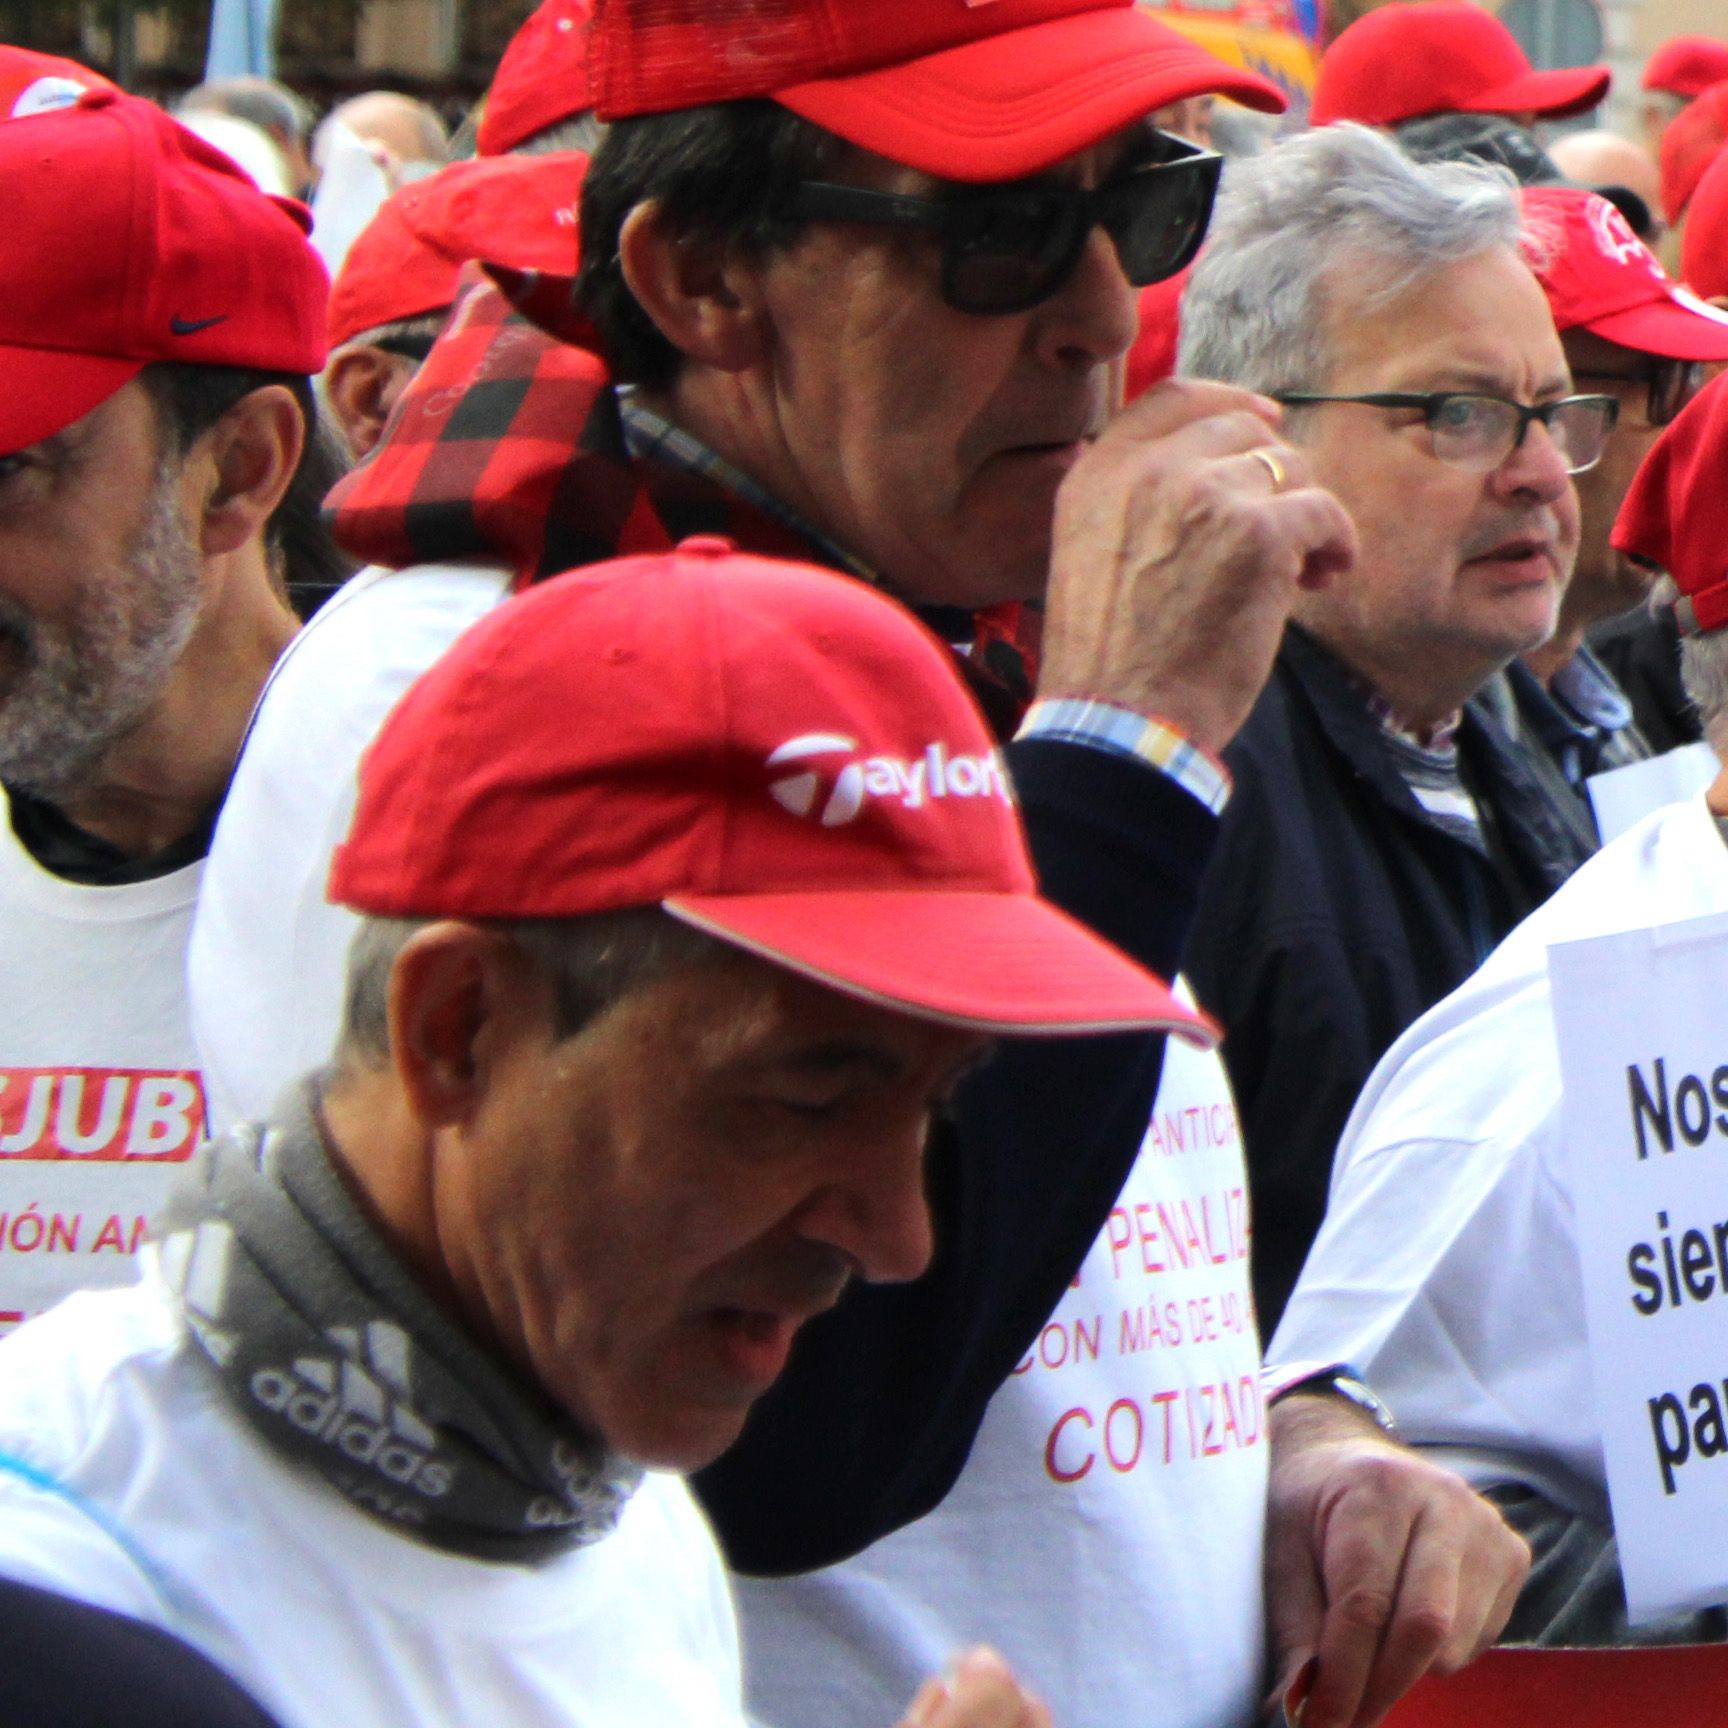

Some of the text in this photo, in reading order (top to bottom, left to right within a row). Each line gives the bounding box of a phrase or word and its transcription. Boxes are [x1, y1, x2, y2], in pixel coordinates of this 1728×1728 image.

[0, 1074, 197, 1155] JUB
[1106, 1187, 1251, 1280] PENALIZ
[1118, 1292, 1182, 1357] MÁS
[1187, 1296, 1219, 1345] DE
[1221, 1291, 1243, 1337] 40
[250, 1367, 454, 1497] adidas
[1044, 1375, 1271, 1484] COTIZAD
